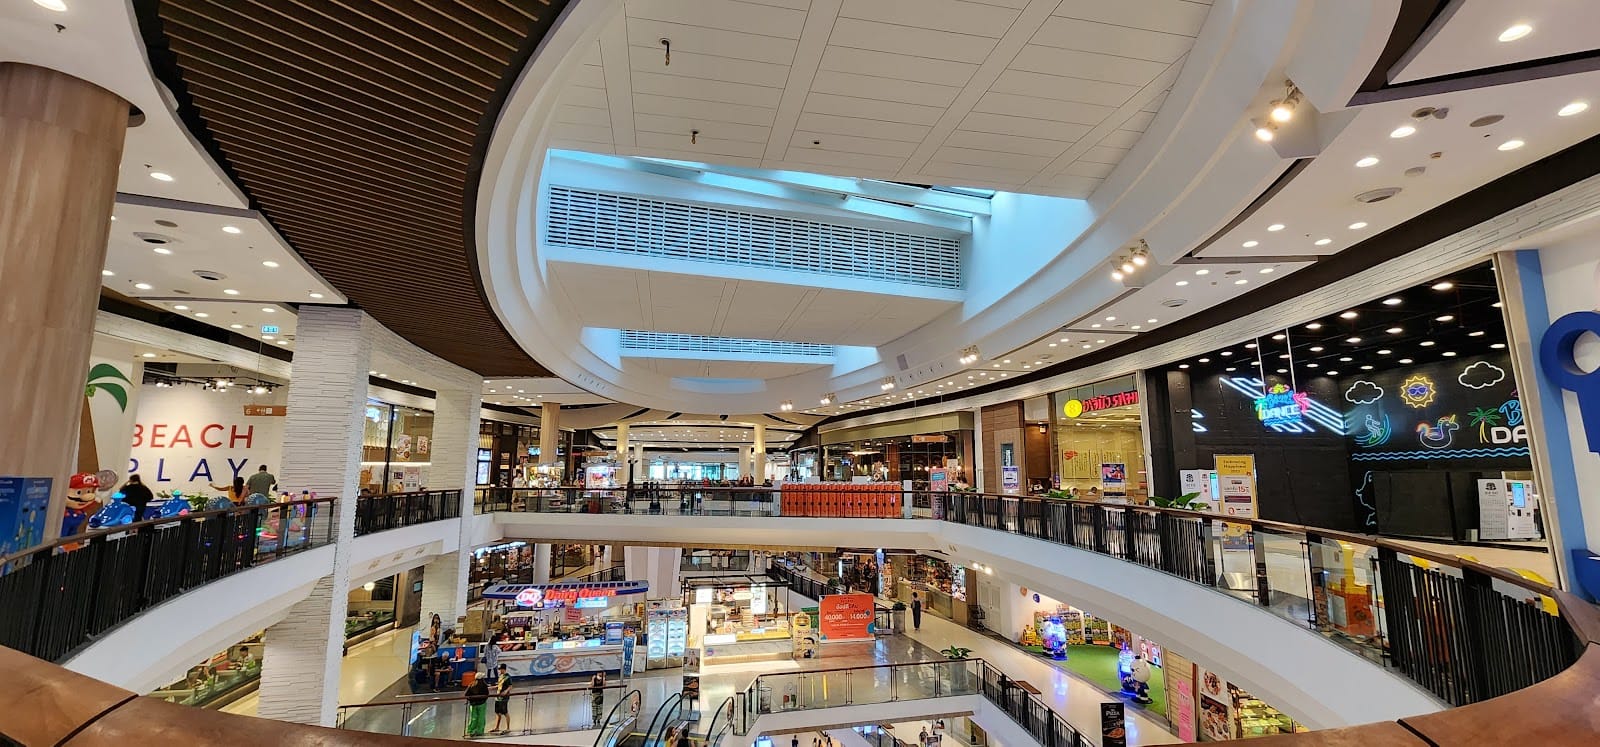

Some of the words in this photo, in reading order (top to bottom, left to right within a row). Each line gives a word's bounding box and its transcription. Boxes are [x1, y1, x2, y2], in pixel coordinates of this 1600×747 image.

[131, 423, 254, 449] BEACH
[522, 592, 537, 601] DQ
[545, 589, 578, 603] Dairy
[578, 588, 616, 598] Queen
